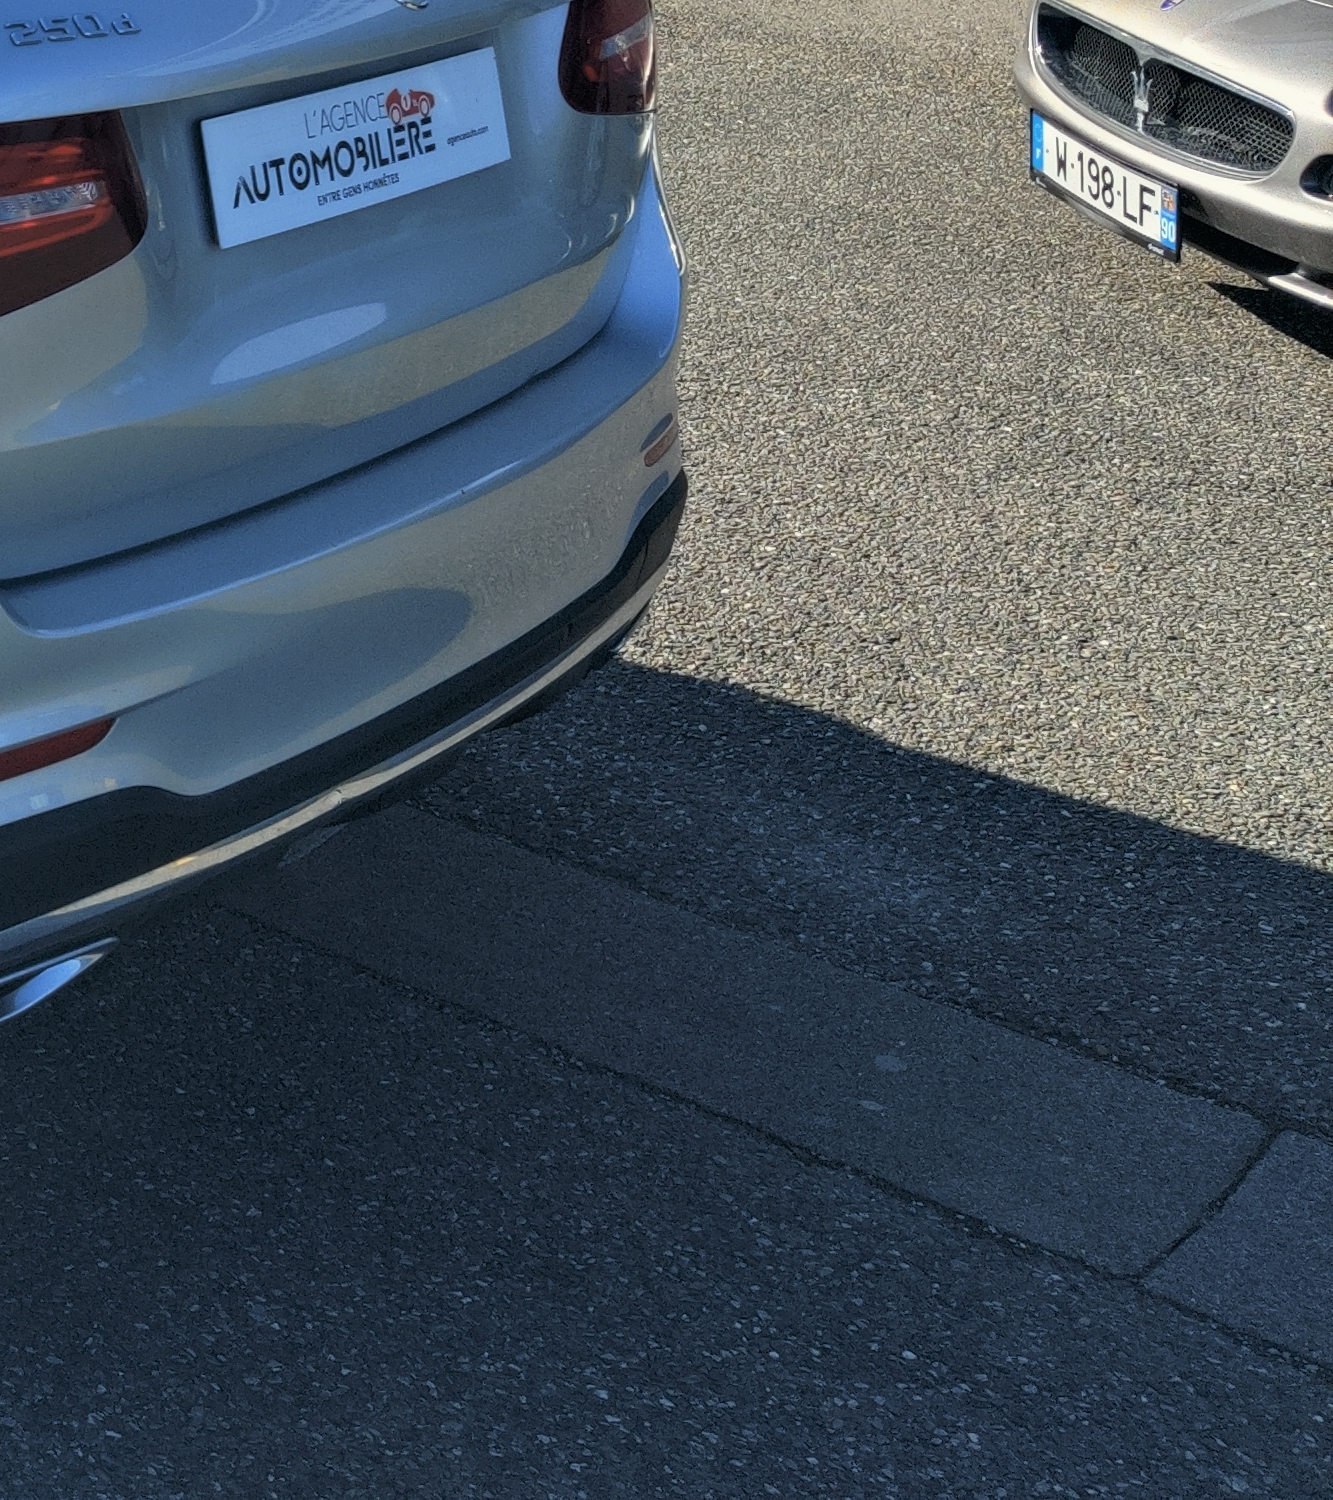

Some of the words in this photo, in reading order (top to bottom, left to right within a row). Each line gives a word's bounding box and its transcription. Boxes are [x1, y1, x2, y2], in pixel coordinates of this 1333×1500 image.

[5, 12, 142, 47] 250d
[303, 92, 390, 140] L'AGENCE
[317, 191, 341, 206] ENTRE
[342, 183, 362, 200] GENS
[1161, 217, 1176, 242] 90
